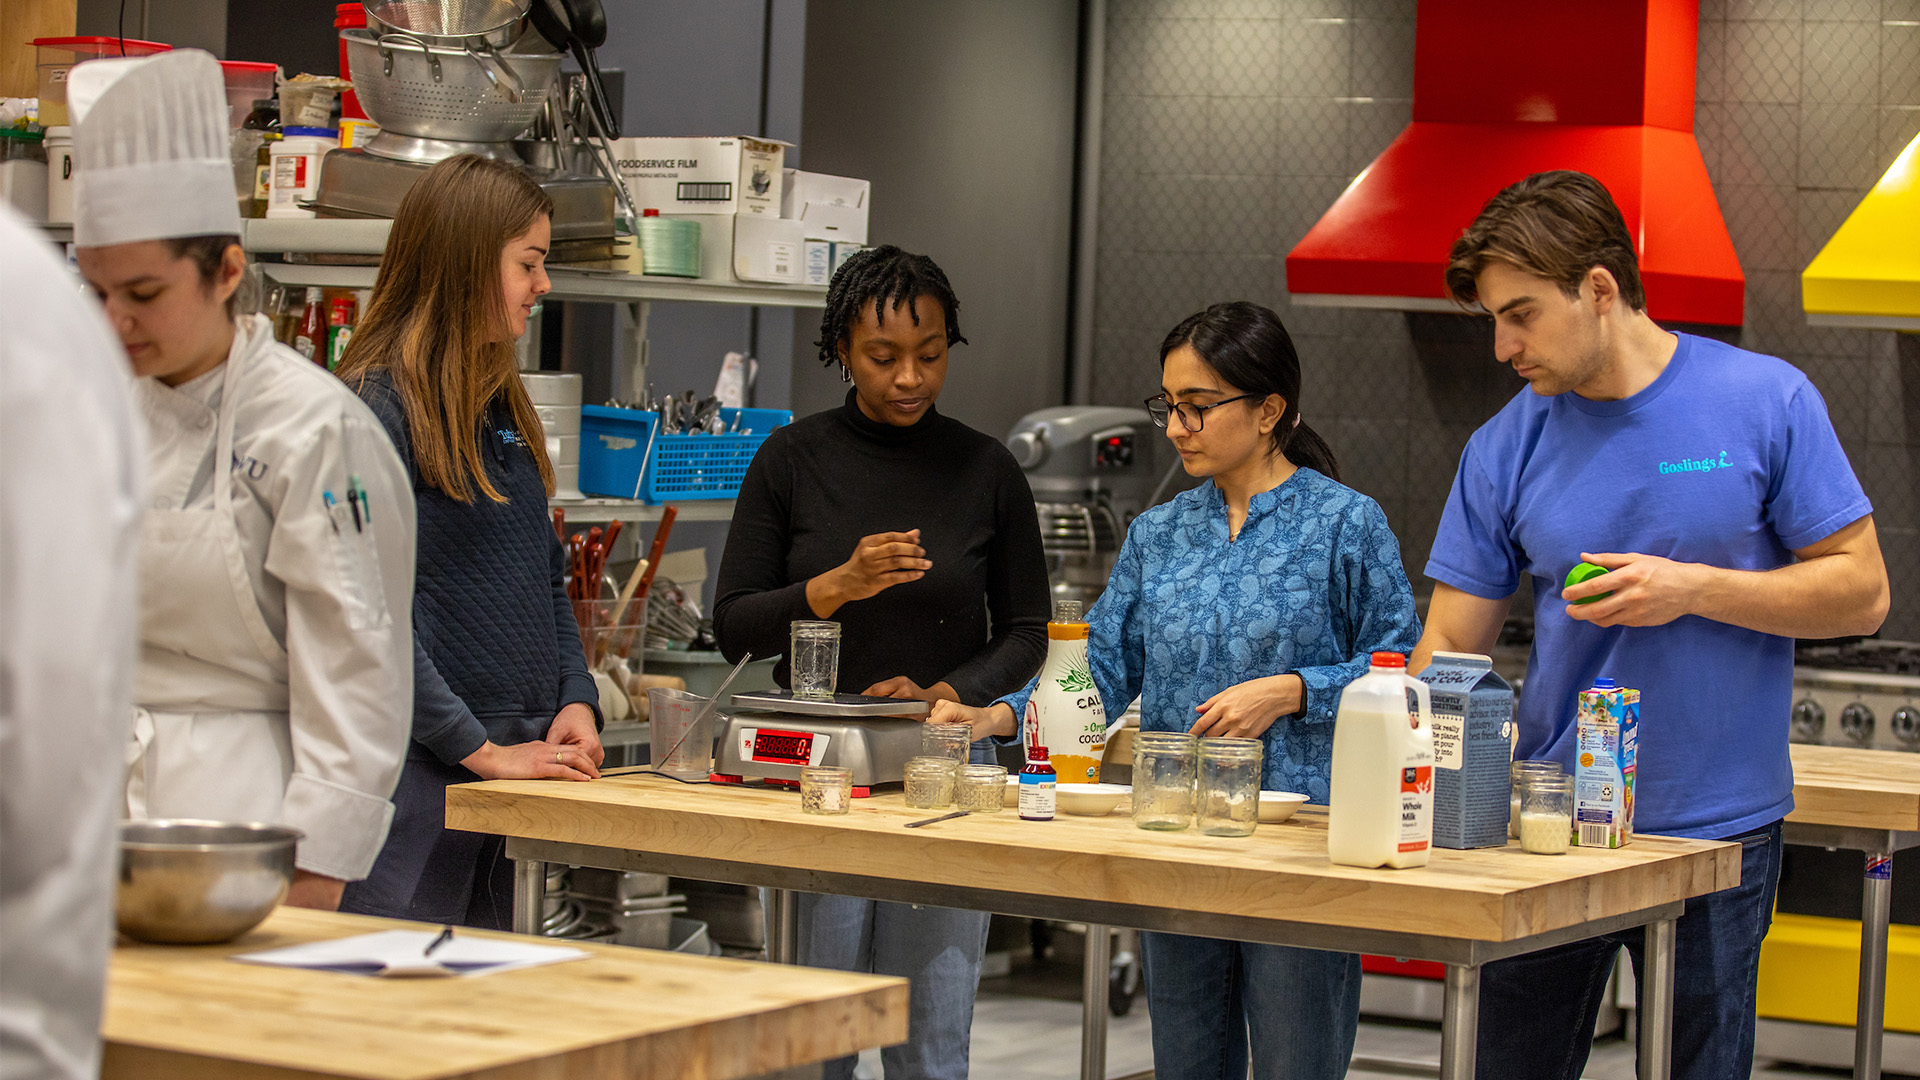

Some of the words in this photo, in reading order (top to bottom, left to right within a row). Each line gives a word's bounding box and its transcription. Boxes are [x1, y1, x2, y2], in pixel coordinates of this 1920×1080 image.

[617, 159, 675, 168] FOODSERVICE
[677, 159, 697, 168] FILM
[1658, 458, 1717, 475] Goslings
[1420, 676, 1437, 684] no
[1438, 675, 1476, 684] cow!
[1431, 695, 1460, 704] EQUENTLY
[1431, 701, 1463, 711] QUESTIONS
[1442, 725, 1460, 733] really
[1402, 802, 1422, 811] Whole
[1402, 812, 1416, 821] Milk
